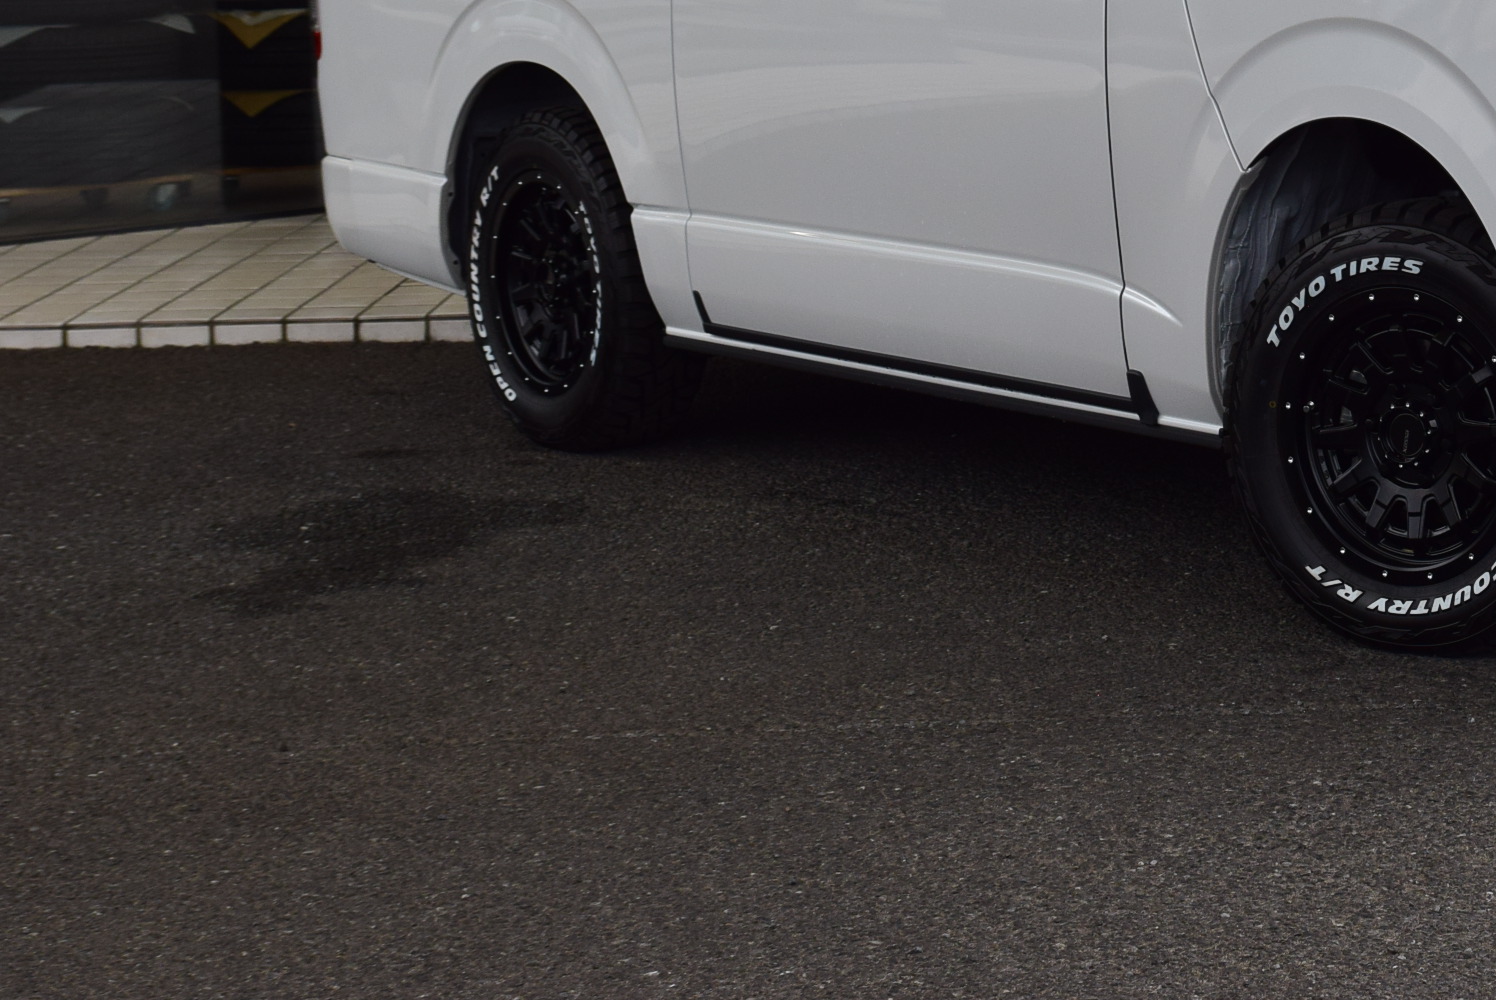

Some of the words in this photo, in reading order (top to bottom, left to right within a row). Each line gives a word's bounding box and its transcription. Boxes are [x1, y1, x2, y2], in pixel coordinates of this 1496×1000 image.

[480, 165, 500, 206] R/T
[469, 210, 487, 338] COUNTRY
[1266, 275, 1328, 348] TOYO
[1330, 257, 1424, 281] TIRES
[482, 345, 517, 402] OPEN
[1305, 565, 1363, 603] R/T
